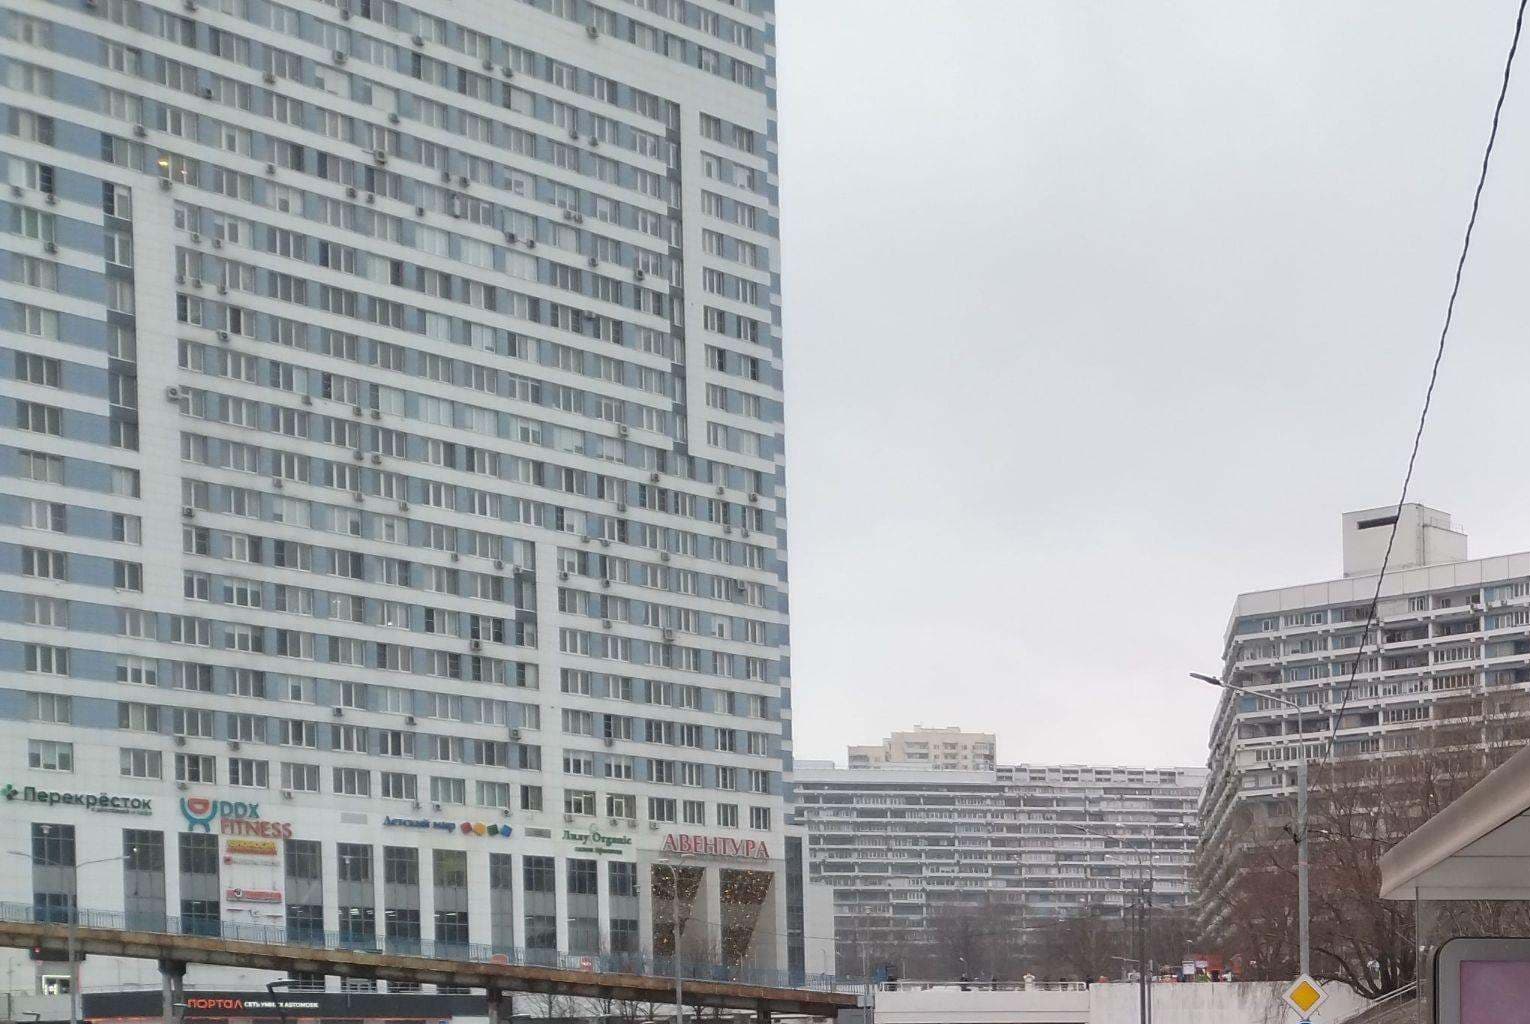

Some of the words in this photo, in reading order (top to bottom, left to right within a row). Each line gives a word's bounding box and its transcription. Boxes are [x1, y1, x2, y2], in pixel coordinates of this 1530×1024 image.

[24, 786, 152, 810] Перекрёсток
[221, 800, 259, 819] DDX
[220, 817, 293, 839] FITNESS
[663, 833, 770, 859] АВЕНТУРА
